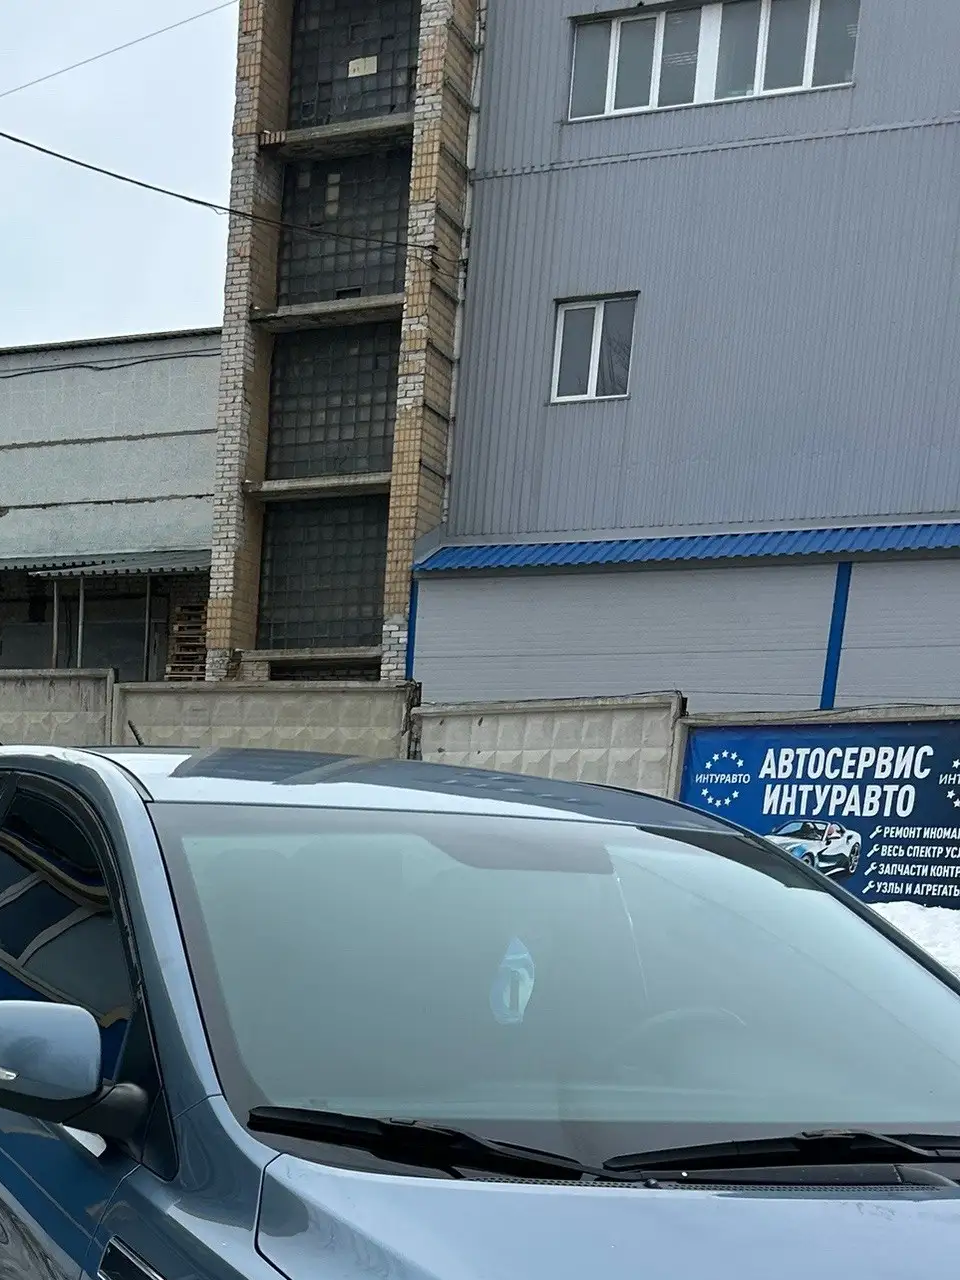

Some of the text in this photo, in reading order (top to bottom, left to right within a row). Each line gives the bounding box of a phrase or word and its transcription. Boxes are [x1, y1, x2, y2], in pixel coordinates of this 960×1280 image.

[759, 745, 934, 780] АВТОСЕРВИС
[695, 773, 751, 784] ИНТУРАВТО
[762, 784, 916, 818] ИНТУРАВТО
[883, 826, 922, 839] РЕМОНТ
[881, 845, 905, 858] ВЕСЬ
[907, 845, 943, 858] СПЕКТР
[878, 863, 929, 876] ЗАПЧАСТИ
[876, 881, 904, 894] УЗЛЫ
[905, 882, 913, 895] И
